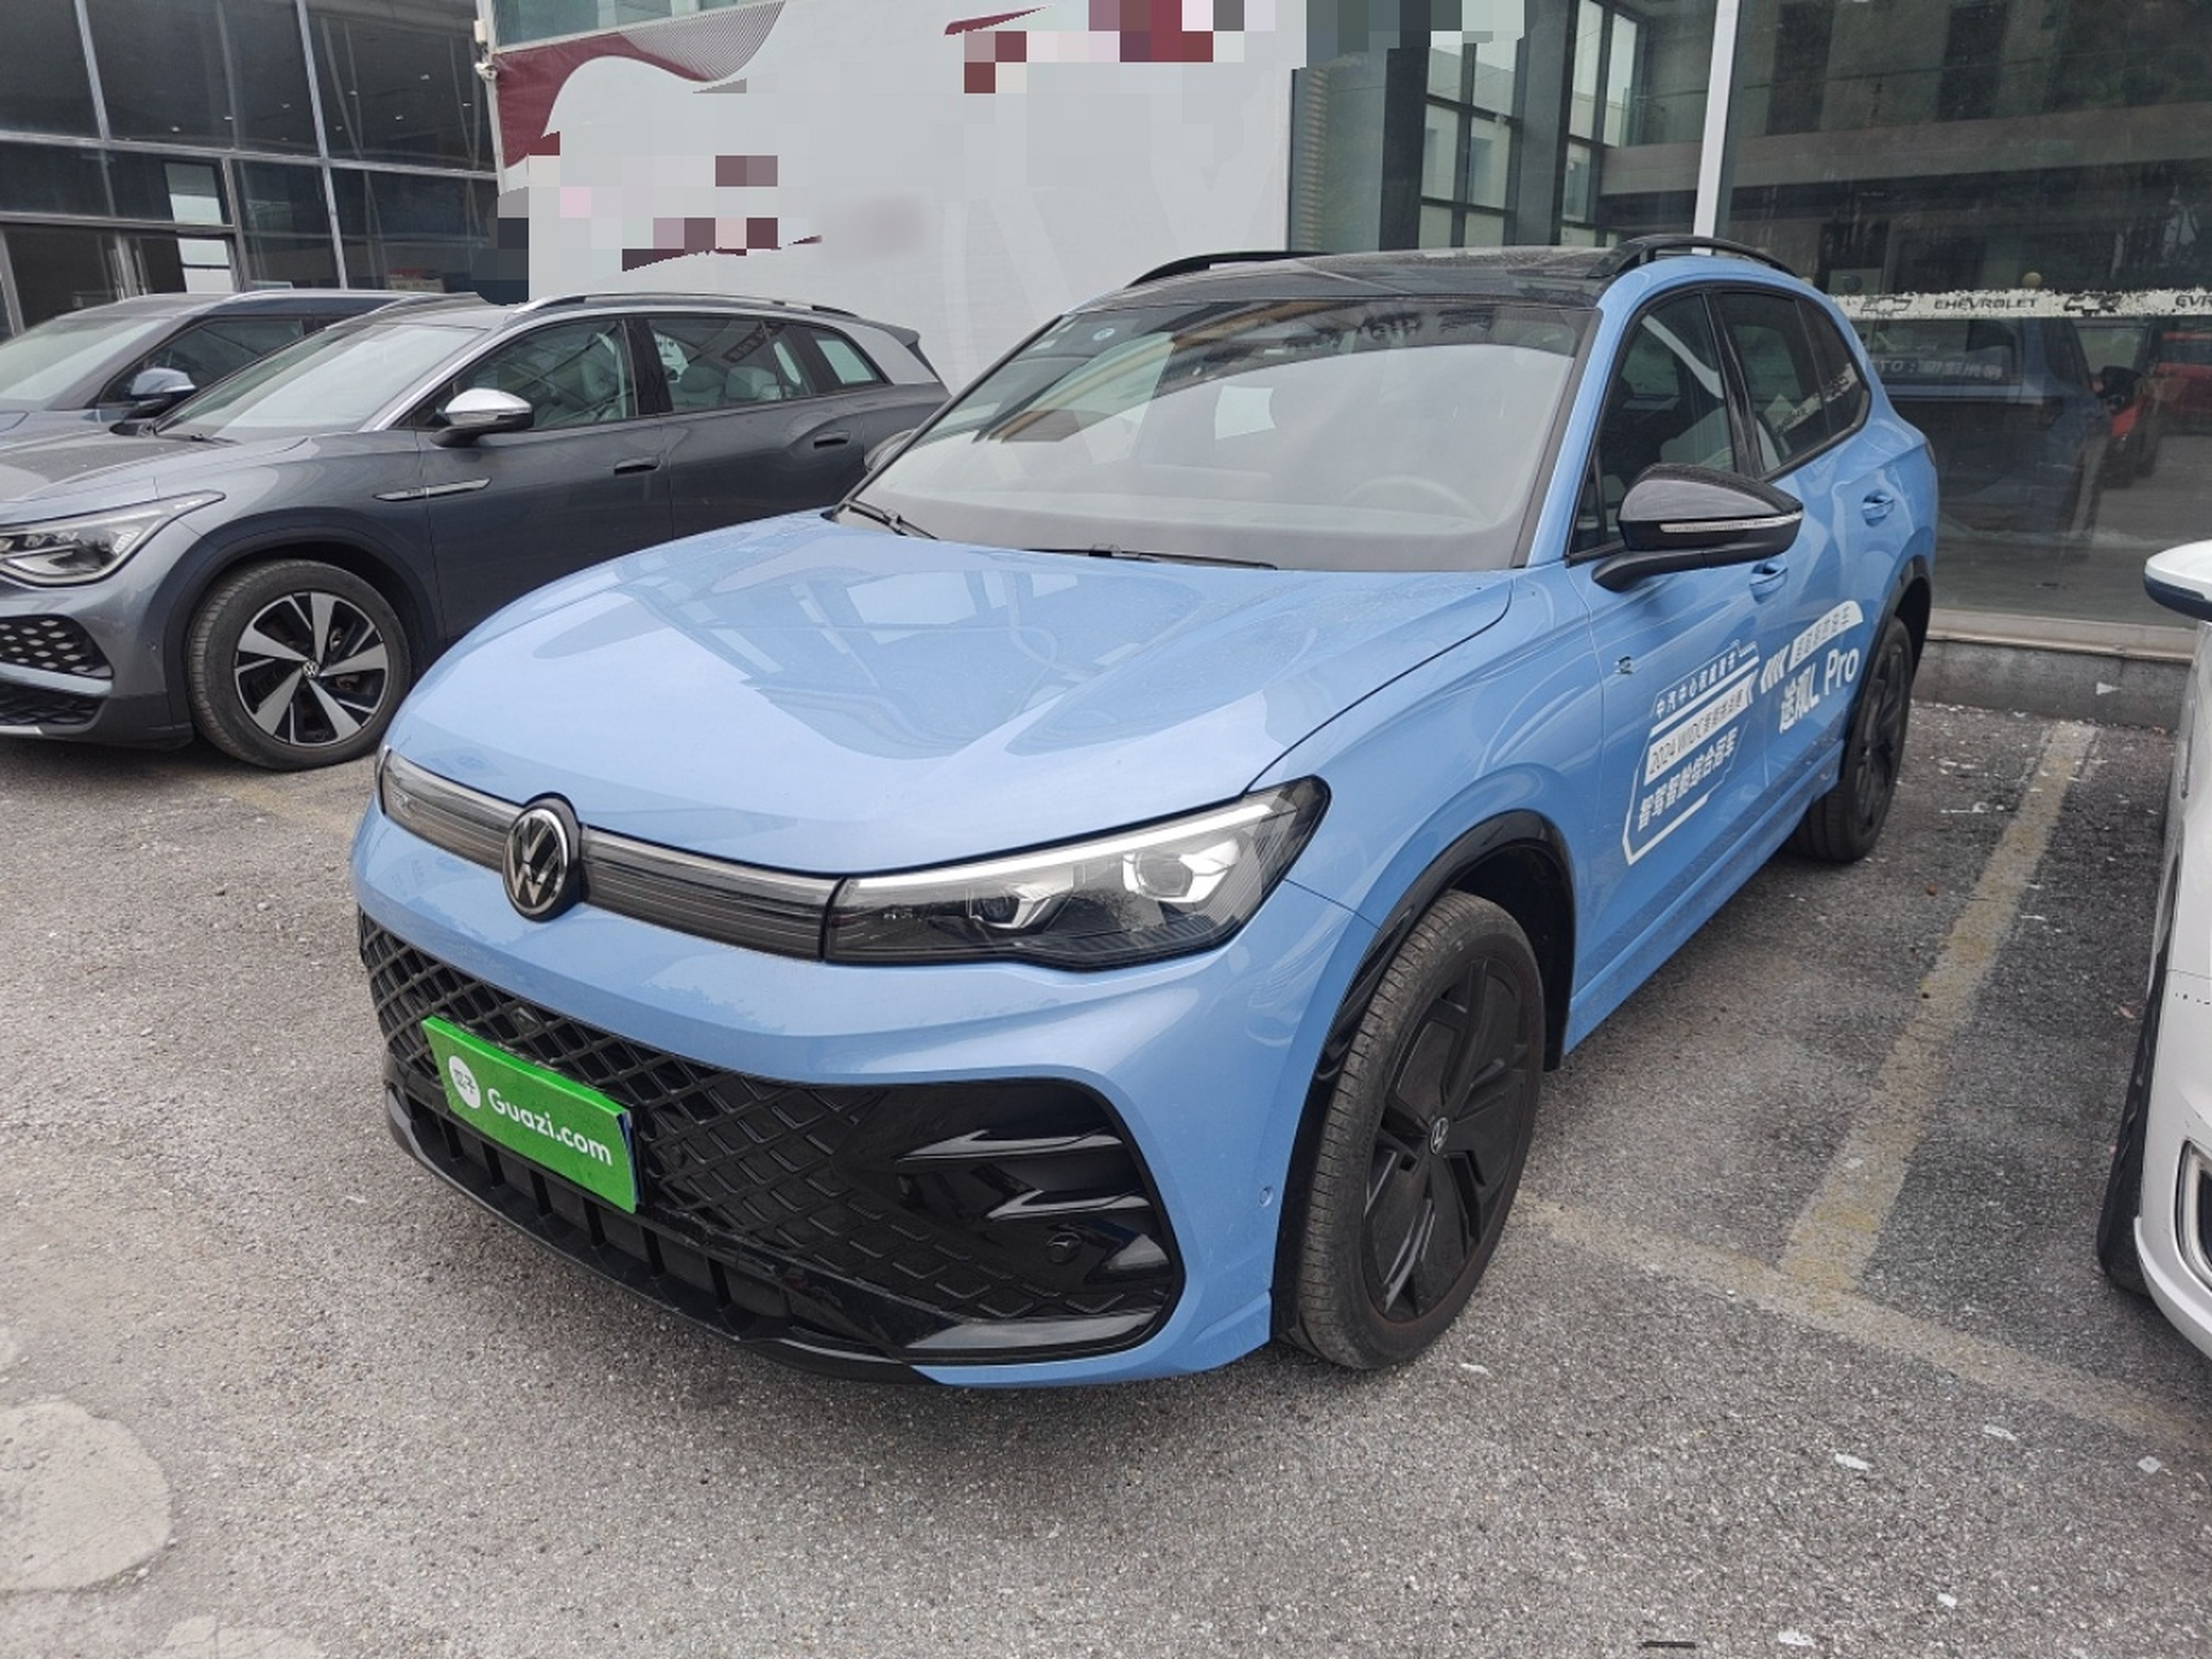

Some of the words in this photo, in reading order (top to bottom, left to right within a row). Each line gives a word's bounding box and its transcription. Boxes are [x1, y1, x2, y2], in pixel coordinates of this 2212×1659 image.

[1934, 297, 2037, 310] CHEVROLET
[1824, 647, 1859, 696] Pro
[487, 1088, 613, 1167] Guazi.com
